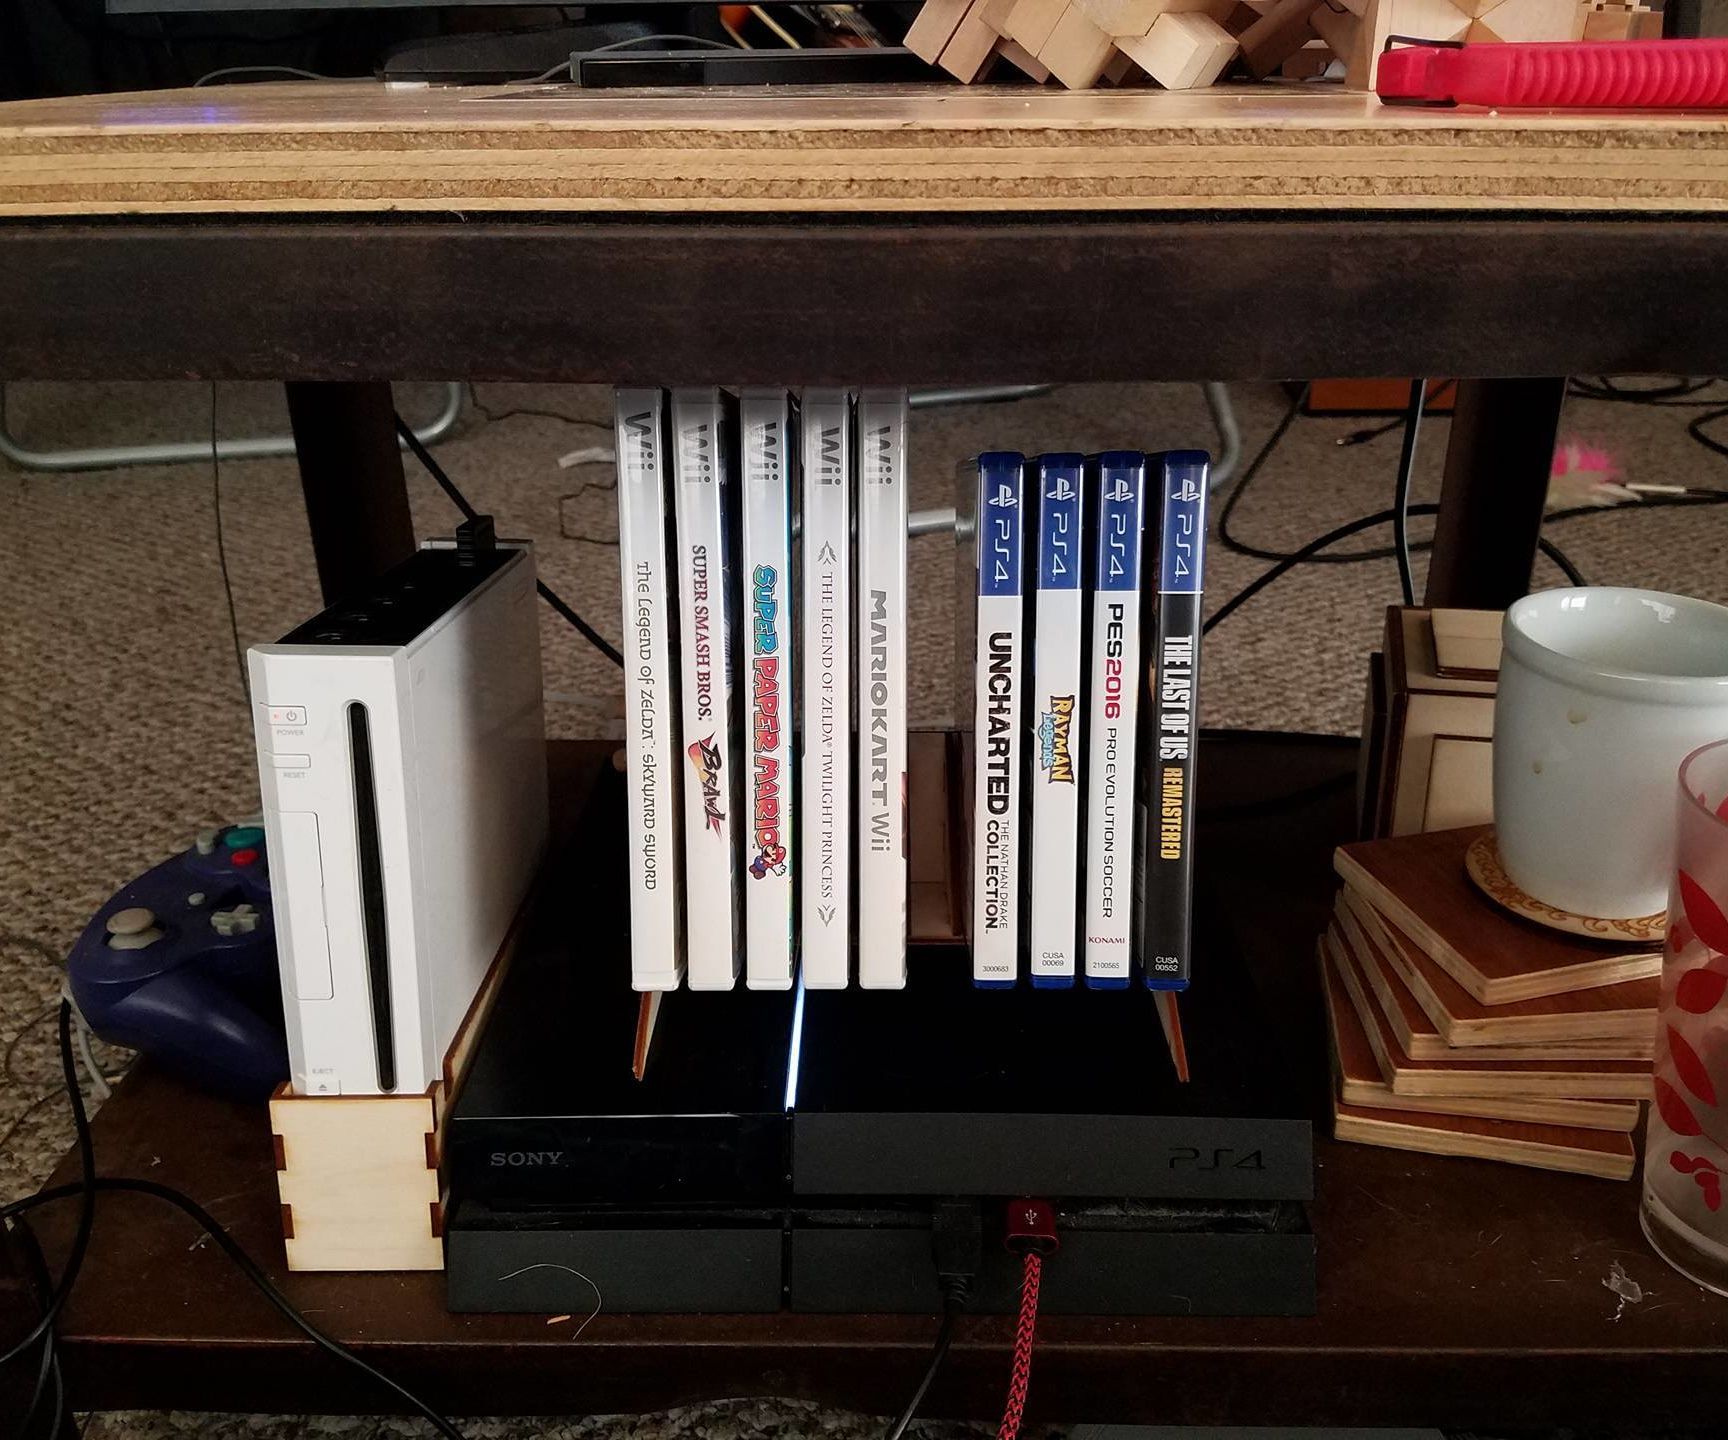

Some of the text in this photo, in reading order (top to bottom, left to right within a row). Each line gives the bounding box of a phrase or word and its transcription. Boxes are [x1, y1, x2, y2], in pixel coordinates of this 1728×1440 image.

[625, 411, 654, 471] Wii
[682, 424, 711, 484] Wii
[751, 422, 779, 481] Wii
[816, 427, 842, 485] Wii
[866, 425, 892, 485] Wii
[994, 519, 1010, 582] PS4
[1052, 513, 1069, 577] PS4
[1109, 513, 1126, 577] PS4
[1175, 514, 1192, 578] PS4
[822, 572, 833, 603] THE
[692, 545, 712, 721] SUPER SMASH BROS.
[822, 608, 833, 669] LEGEND
[753, 564, 781, 848] SUPER PAPER MARIO
[821, 672, 834, 694] OF
[1159, 635, 1193, 761] THE LAST OF US
[987, 632, 1012, 816] UNCHARTED
[1049, 695, 1075, 784] RAYMAN
[821, 753, 833, 828] TWILIGHT
[1160, 767, 1183, 860] REMASTERED
[871, 812, 891, 852] Wii
[1102, 728, 1117, 918] PRO EVOLUTION SOCCER
[821, 831, 833, 898] PRINCESS
[985, 819, 1000, 929] COLLECTION
[998, 820, 1010, 929] THE NATHAN DRAKE
[1088, 936, 1126, 944] KONAMI
[1154, 964, 1178, 972] 00552
[1155, 956, 1179, 964] CUSA
[490, 1151, 563, 1166] SONY
[1168, 1147, 1267, 1169] PS4
